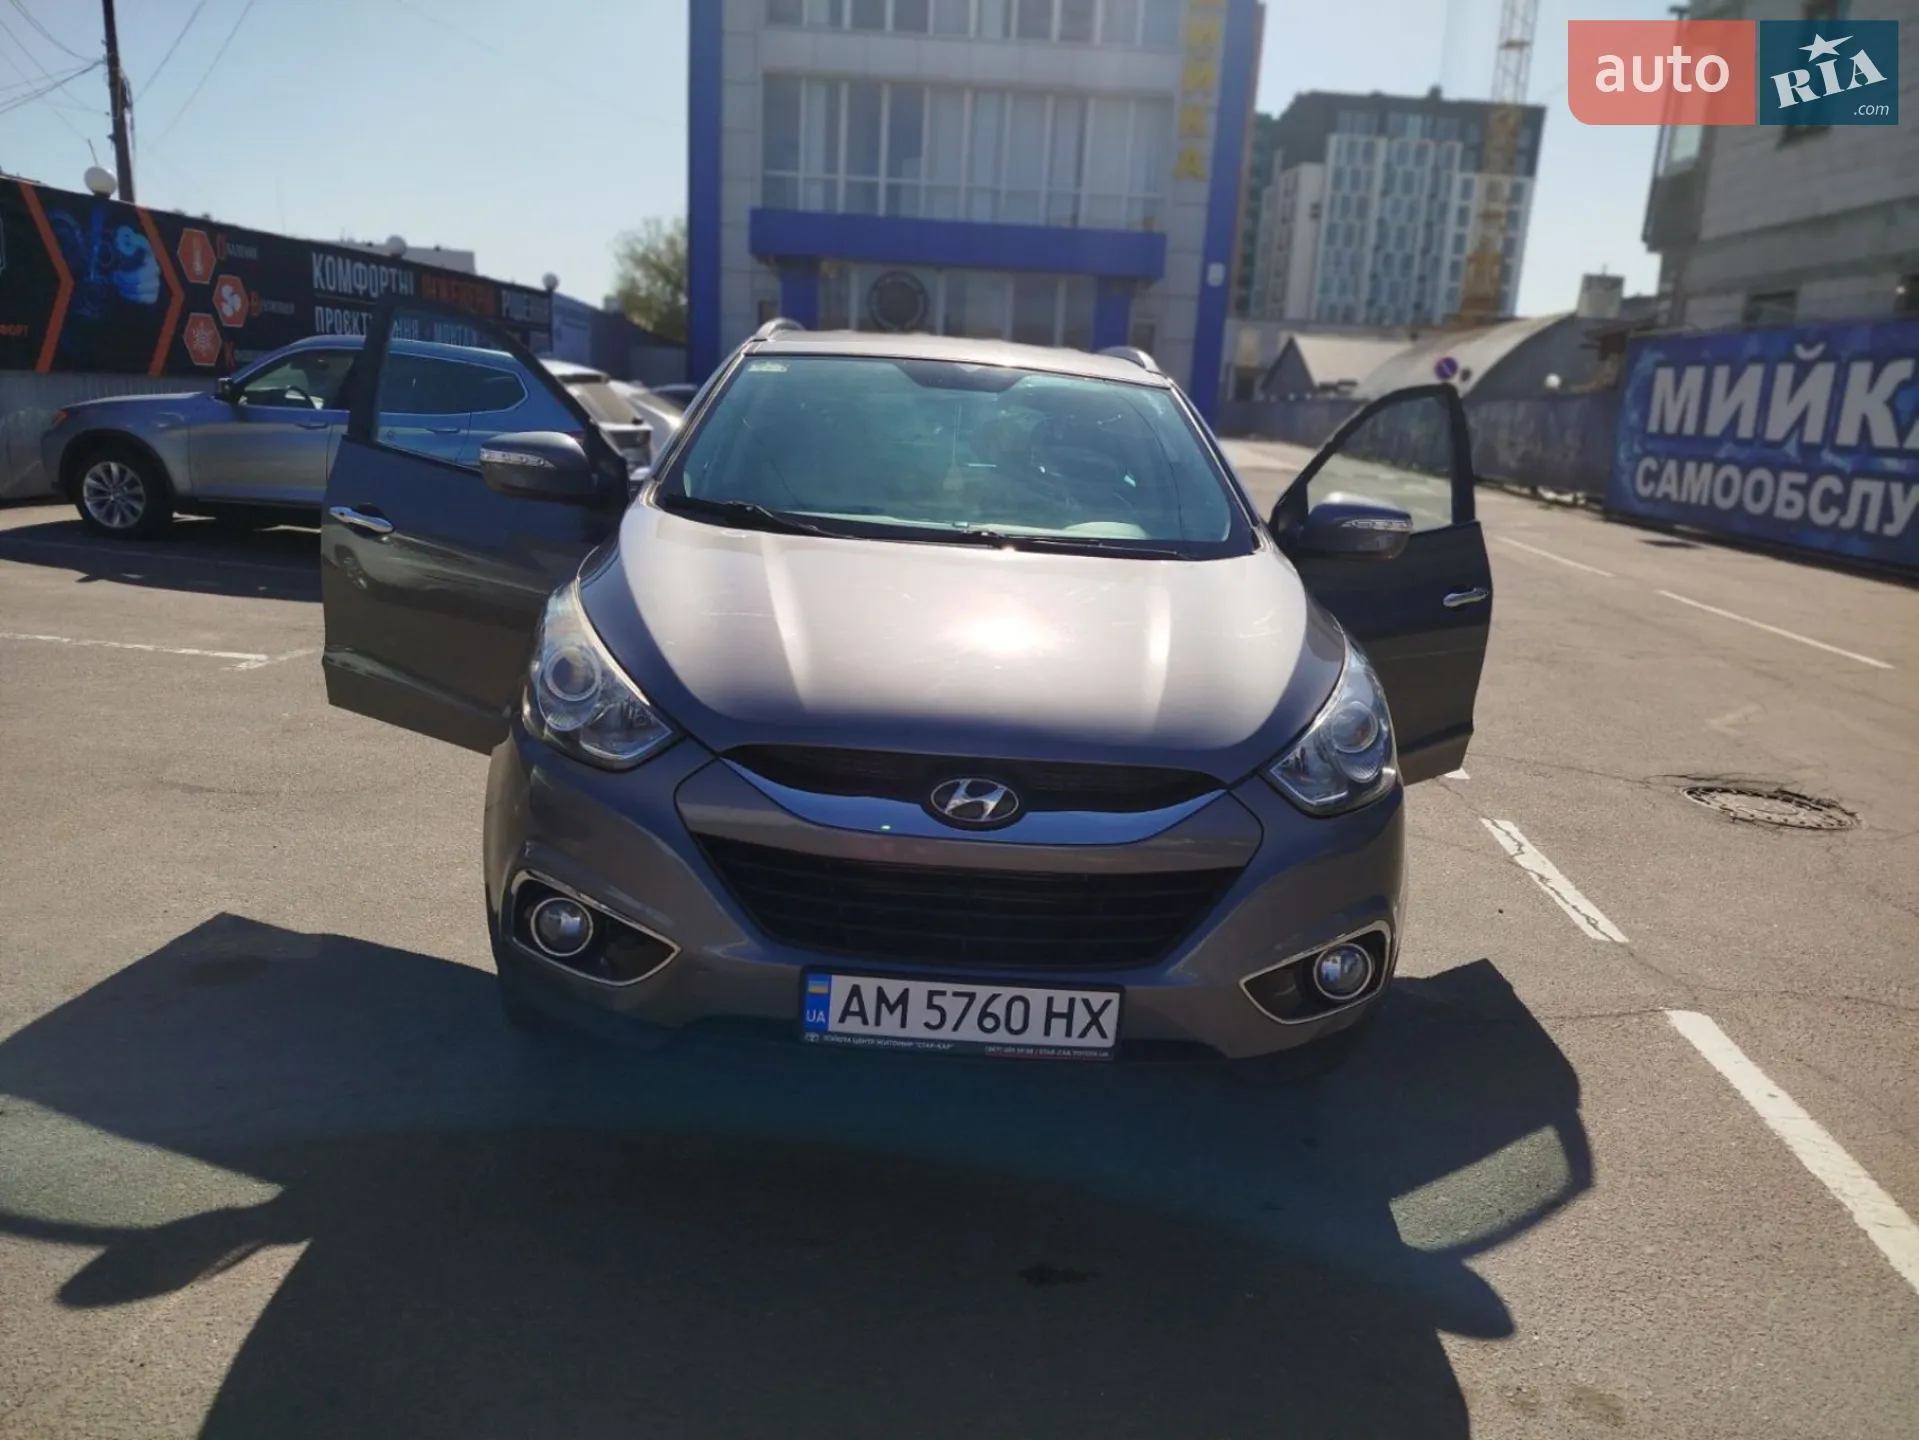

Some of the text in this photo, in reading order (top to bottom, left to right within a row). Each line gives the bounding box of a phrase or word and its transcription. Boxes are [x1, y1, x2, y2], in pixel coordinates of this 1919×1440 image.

[1647, 342, 1919, 449] МИЙК
[1635, 456, 1919, 538] САМООБСЛУ
[805, 1010, 827, 1024] UA
[838, 984, 1113, 1040] AM 5760 HX
